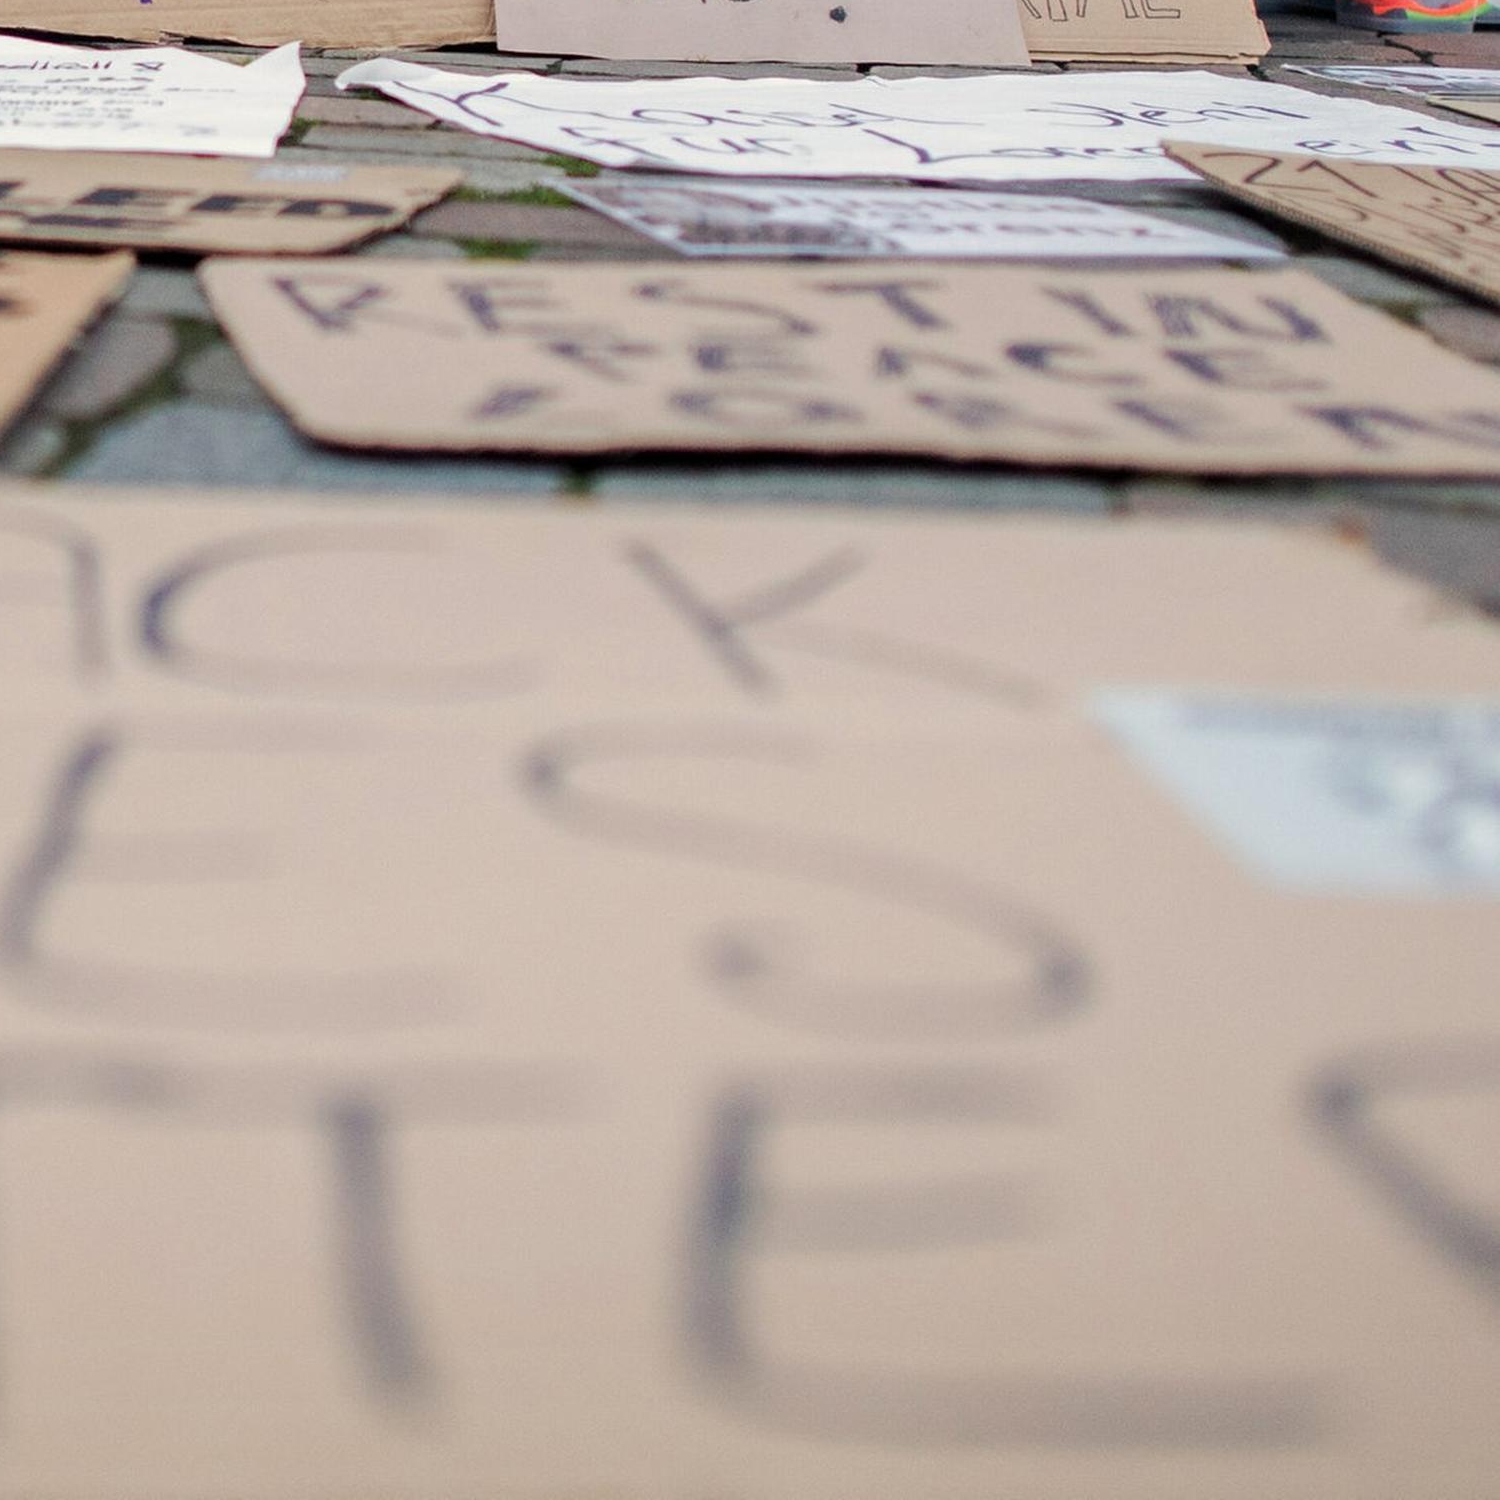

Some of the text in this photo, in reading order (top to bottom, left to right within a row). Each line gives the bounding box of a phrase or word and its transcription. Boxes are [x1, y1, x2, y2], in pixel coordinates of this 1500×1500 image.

[268, 274, 1330, 343] REST IN
[470, 384, 1500, 450] LOREN
